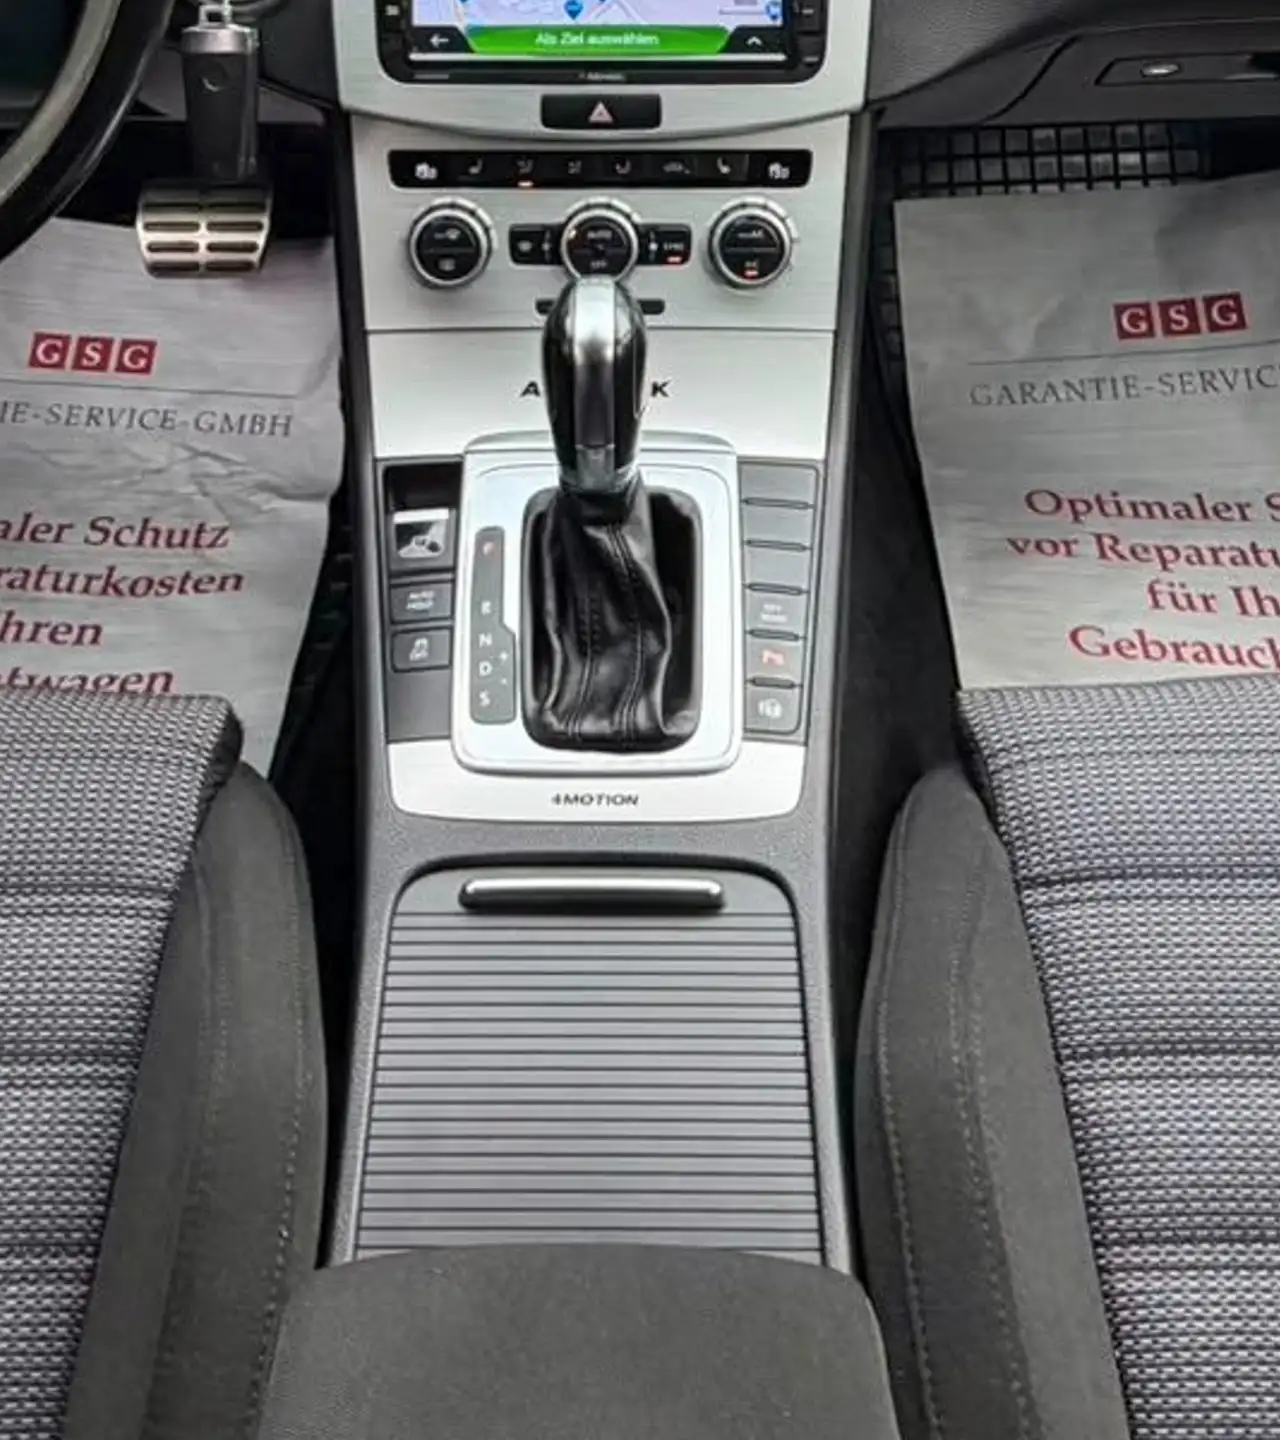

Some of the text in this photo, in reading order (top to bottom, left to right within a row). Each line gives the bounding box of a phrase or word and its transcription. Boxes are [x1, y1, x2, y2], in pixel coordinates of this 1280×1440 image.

[1117, 295, 1244, 337] GSG
[33, 335, 155, 373] GSG
[1024, 489, 1252, 524] Optimaler
[83, 516, 230, 550] Schutz
[1007, 536, 1079, 558] vor
[1146, 578, 1217, 615] für
[478, 632, 492, 647] N
[478, 661, 493, 677] D
[478, 689, 491, 707] S
[551, 792, 640, 807] 4MOTION
